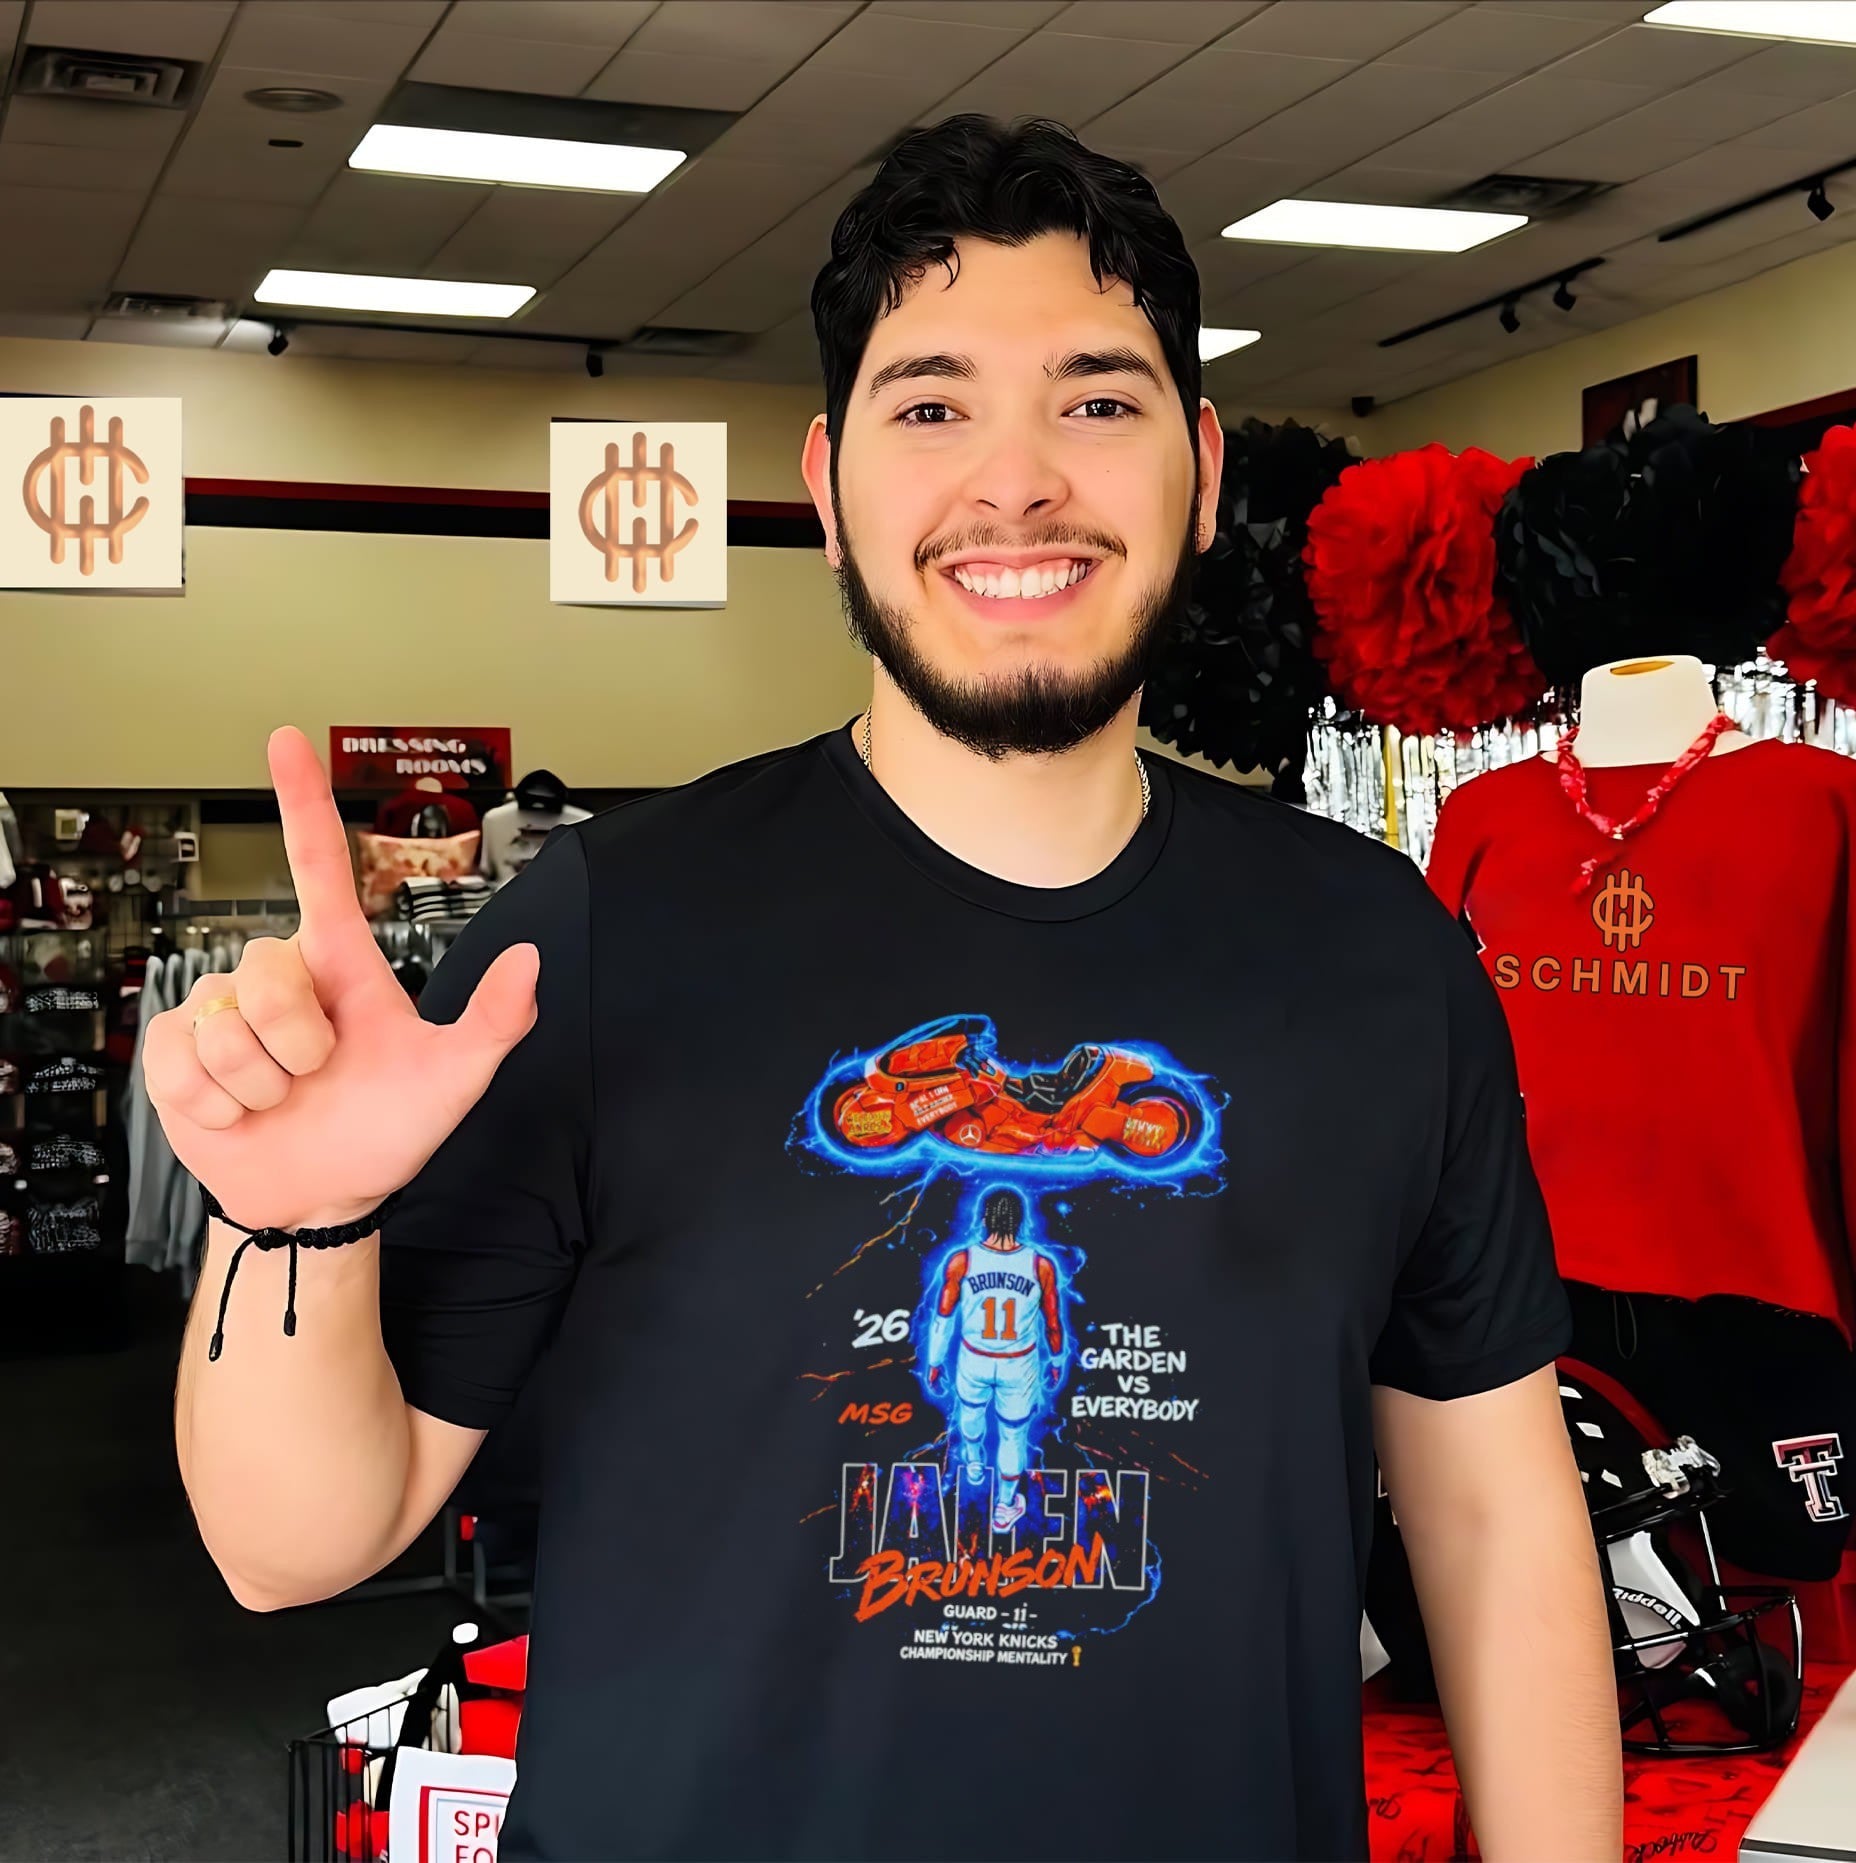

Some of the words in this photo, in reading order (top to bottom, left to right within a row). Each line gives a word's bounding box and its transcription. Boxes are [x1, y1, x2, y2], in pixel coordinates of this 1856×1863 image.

[396, 758, 487, 775] ROOMS
[1494, 953, 1747, 1001] SCHMIDT
[967, 1271, 1037, 1297] BRUNSON
[980, 1296, 1018, 1341] 11
[1100, 1322, 1162, 1349] THE
[1080, 1347, 1187, 1373] GARDEN
[1116, 1375, 1151, 1395] VS
[838, 1401, 914, 1425] MSG
[1070, 1396, 1200, 1421] EVERYBODY
[854, 1530, 1104, 1623] BRUNSON
[943, 1603, 998, 1620] GUARD
[914, 1629, 949, 1645] NEW
[951, 1631, 995, 1647] YORK
[998, 1633, 1059, 1650] KNICKS
[900, 1646, 995, 1662] CHAMPIONSHIP
[997, 1650, 1068, 1665] MENTALITY
